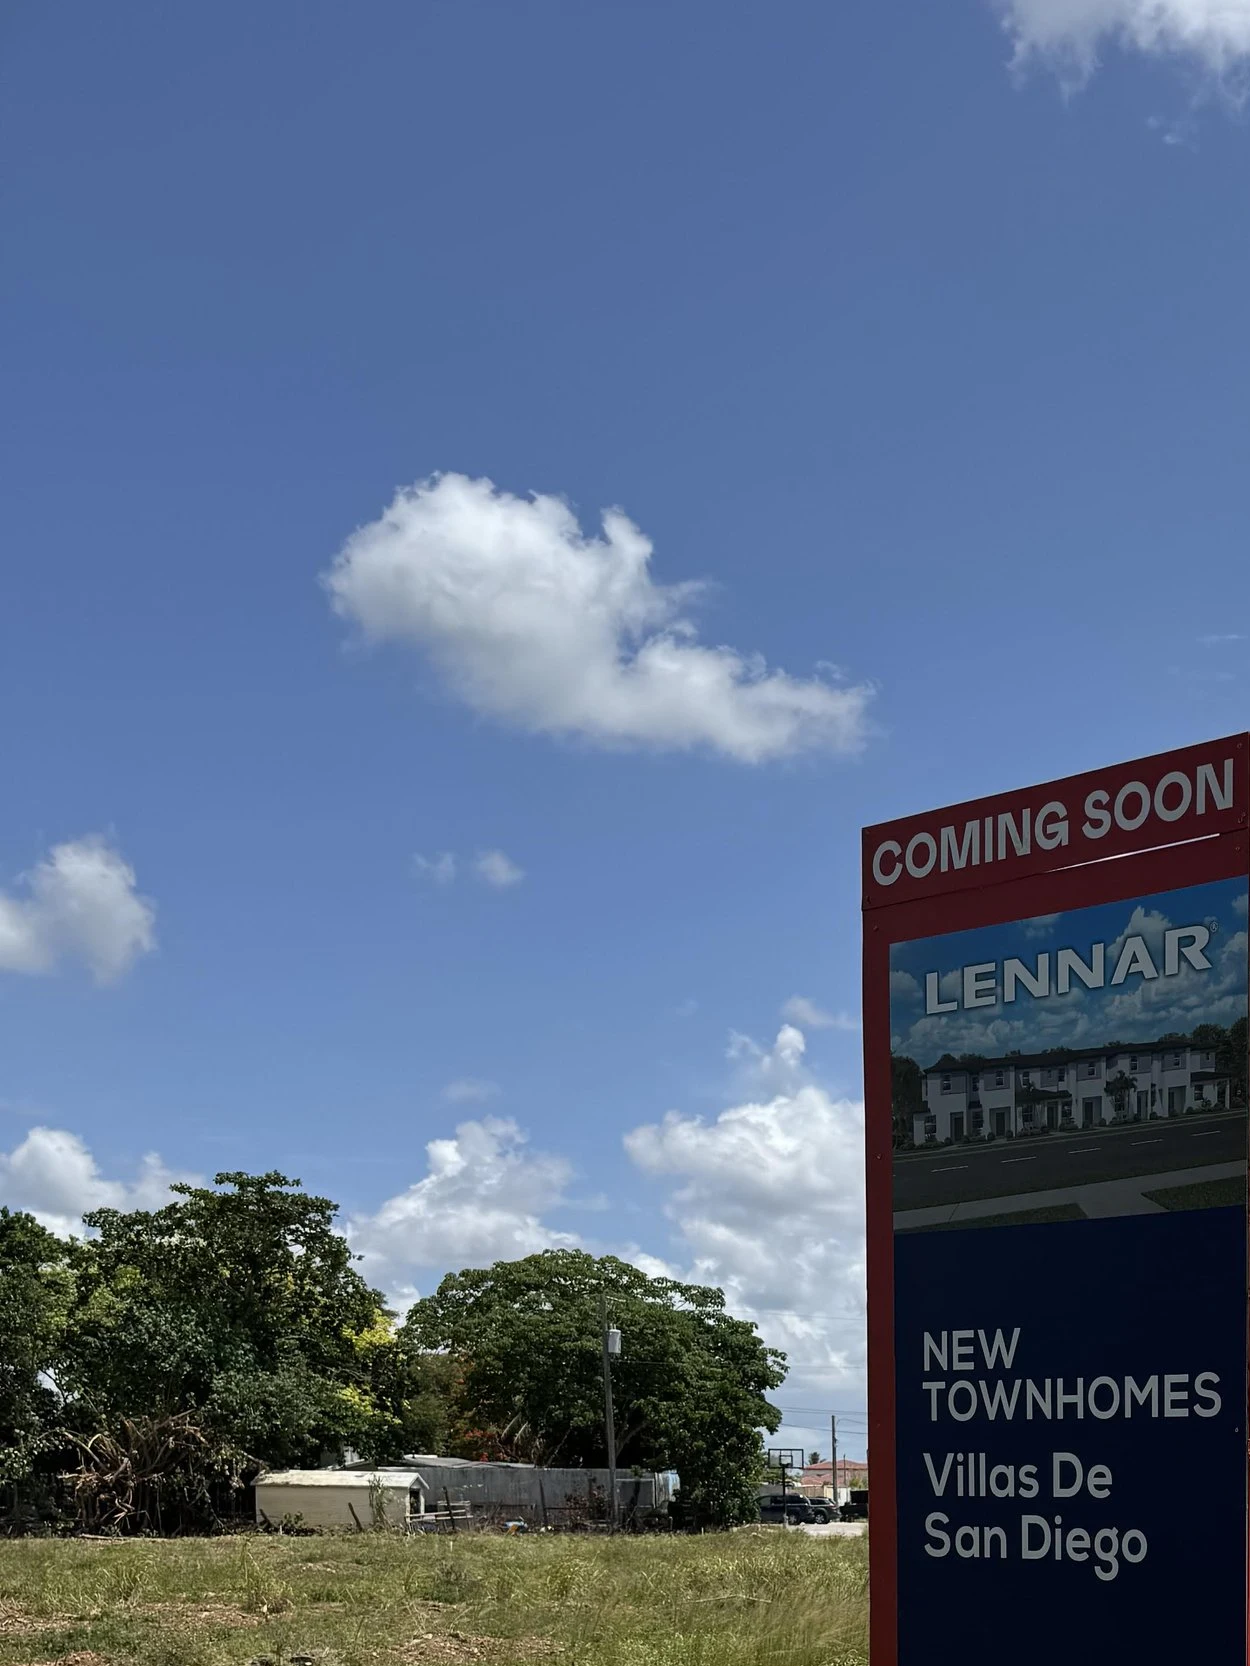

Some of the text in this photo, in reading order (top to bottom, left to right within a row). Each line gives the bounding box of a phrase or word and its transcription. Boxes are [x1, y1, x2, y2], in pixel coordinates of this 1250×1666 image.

[872, 758, 1233, 886] COMING SOON
[923, 1327, 1021, 1371] NEW
[922, 1372, 1222, 1422] TOWNHOMES
[922, 1452, 1113, 1499] Villas De
[924, 1512, 1148, 1581] San Diego
